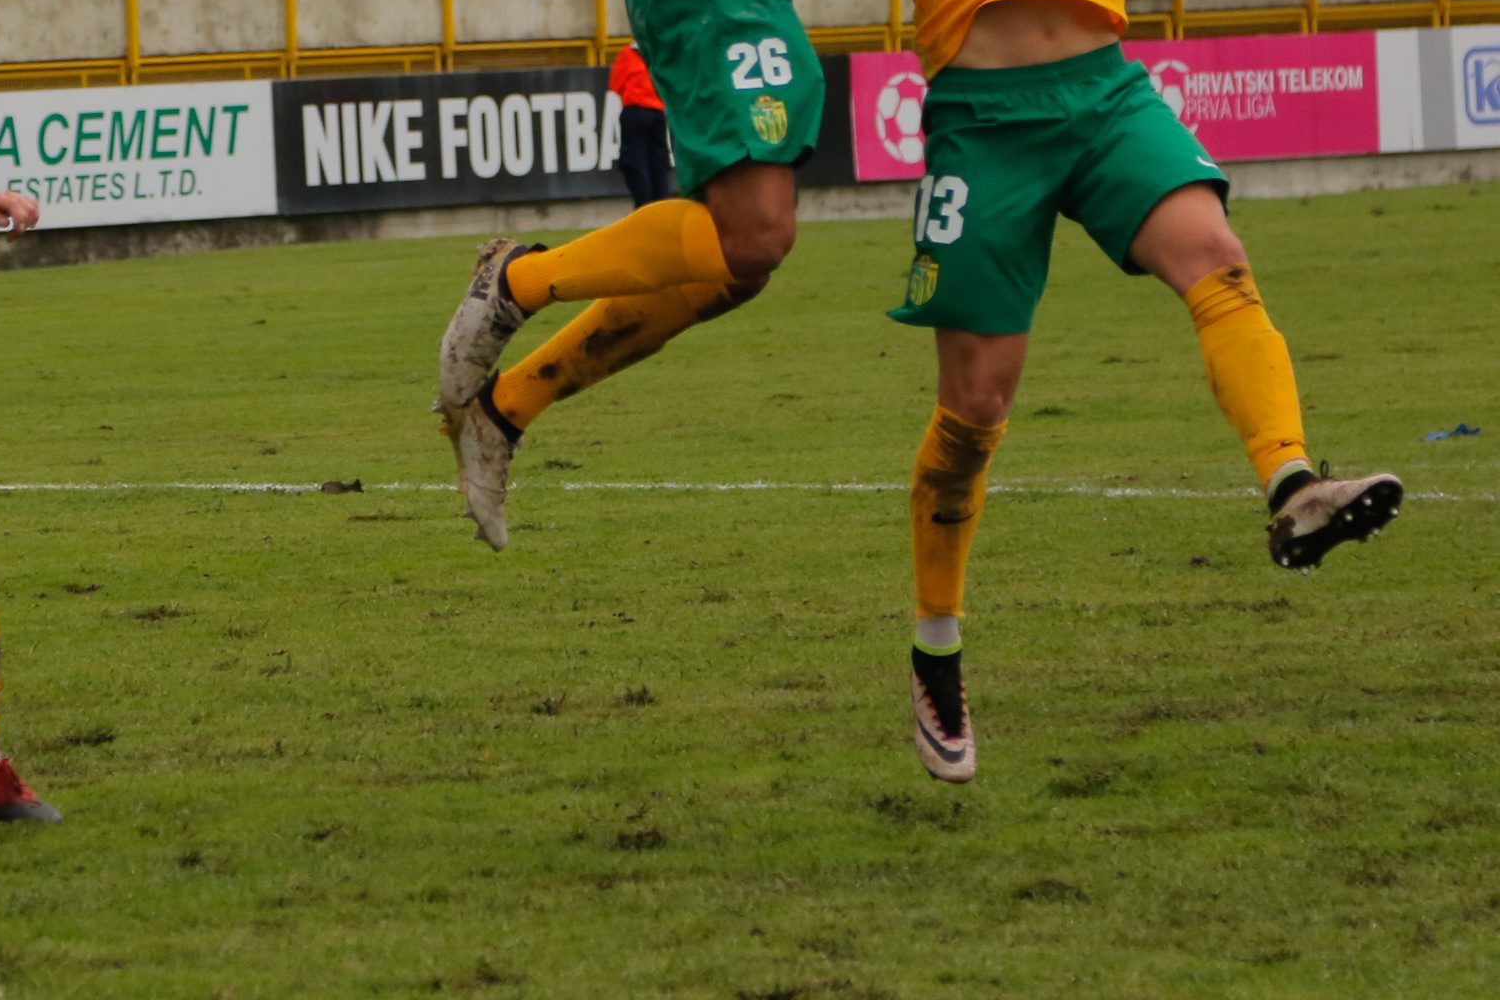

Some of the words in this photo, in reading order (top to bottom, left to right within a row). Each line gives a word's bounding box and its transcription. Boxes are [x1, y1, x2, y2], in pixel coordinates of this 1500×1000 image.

[726, 37, 793, 90] 26
[1183, 69, 1275, 97] HRVATSKI
[1278, 65, 1363, 94] TELEKOM
[1184, 96, 1233, 120] PRVA
[1235, 94, 1276, 119] LIGA
[36, 105, 249, 166] CEMENT
[302, 101, 426, 187] NIKE
[134, 169, 203, 200] L.T.D.
[916, 175, 969, 244] 13
